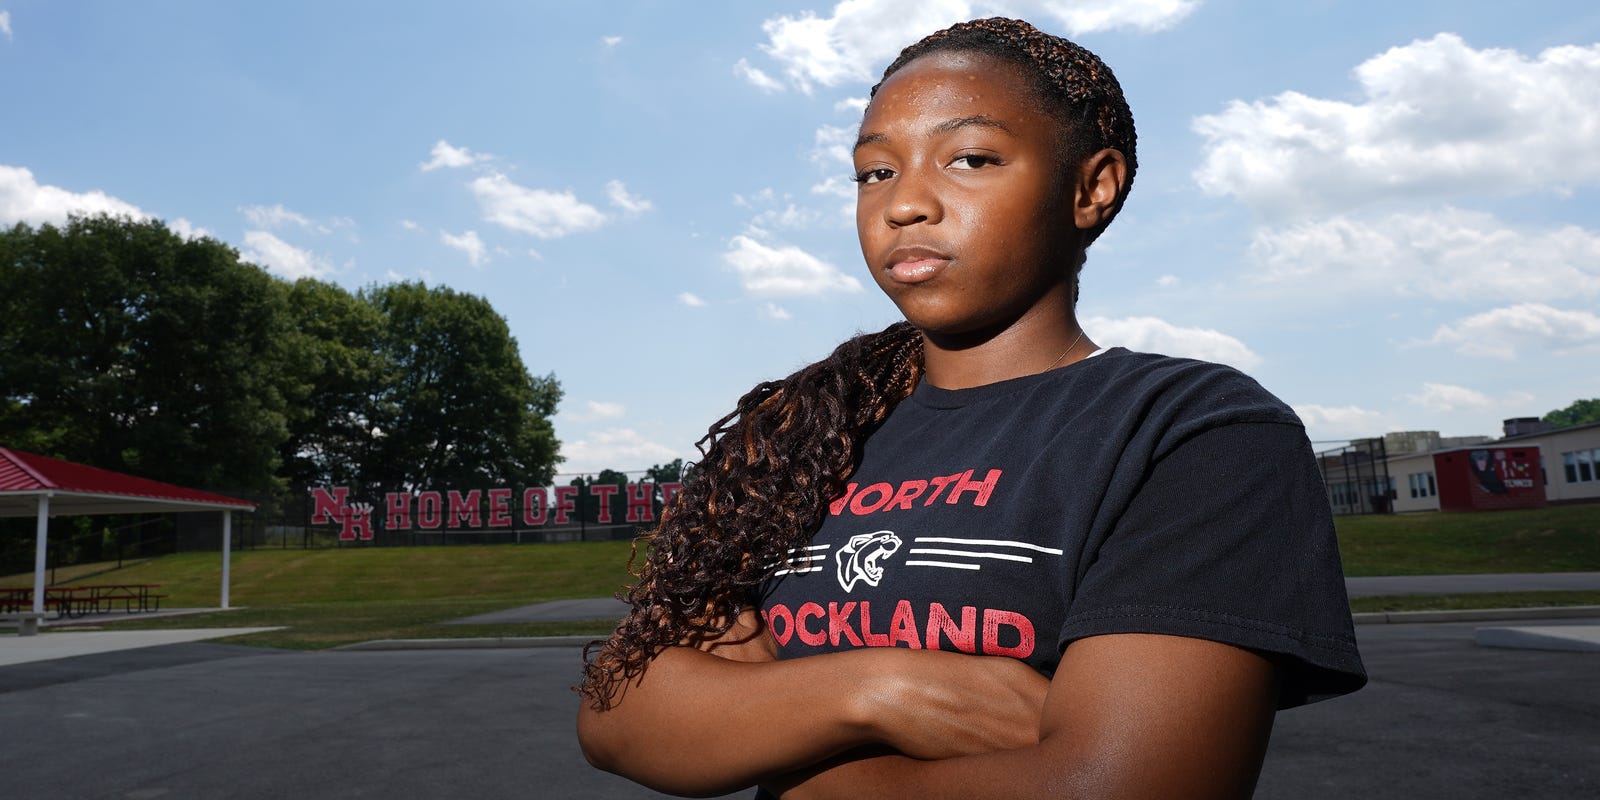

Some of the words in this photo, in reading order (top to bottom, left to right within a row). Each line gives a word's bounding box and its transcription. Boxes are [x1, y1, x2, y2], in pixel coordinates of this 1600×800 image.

[385, 488, 513, 530] HOME
[523, 485, 579, 526] OF
[761, 599, 1036, 659] OCKLAND
